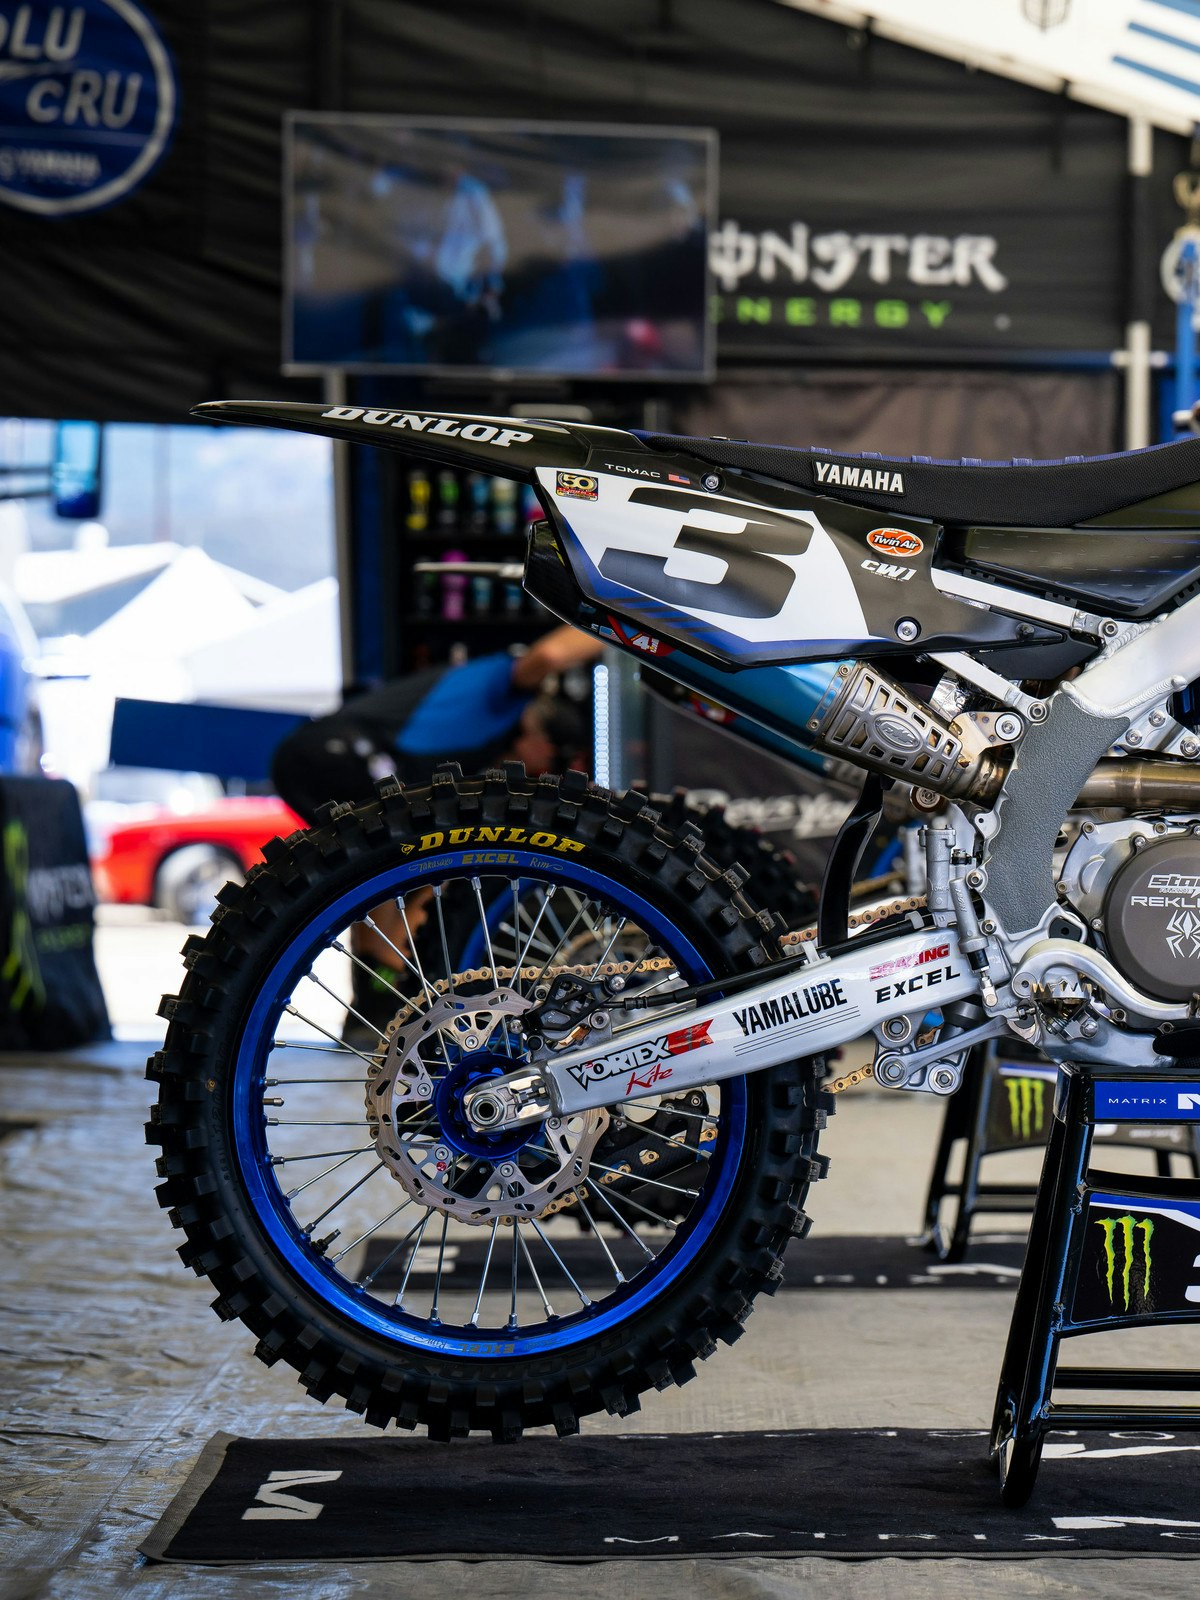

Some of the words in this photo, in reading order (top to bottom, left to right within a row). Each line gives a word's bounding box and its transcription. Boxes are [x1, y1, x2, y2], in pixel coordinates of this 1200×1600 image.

[0, 4, 86, 61] LU
[708, 219, 1007, 293] ONSTER
[321, 406, 534, 448] DUNLOP
[562, 473, 594, 490] 50
[604, 463, 661, 478] TOMAC
[815, 461, 904, 494] YAMAHA
[598, 486, 814, 619] 3
[874, 534, 900, 547] Twin
[900, 539, 919, 550] Air
[418, 826, 587, 853] DUNLOP
[461, 853, 519, 865] EXCEL
[875, 966, 960, 1004] EXCEL
[732, 978, 848, 1037] YAMALUBE
[626, 1063, 674, 1095] Kite
